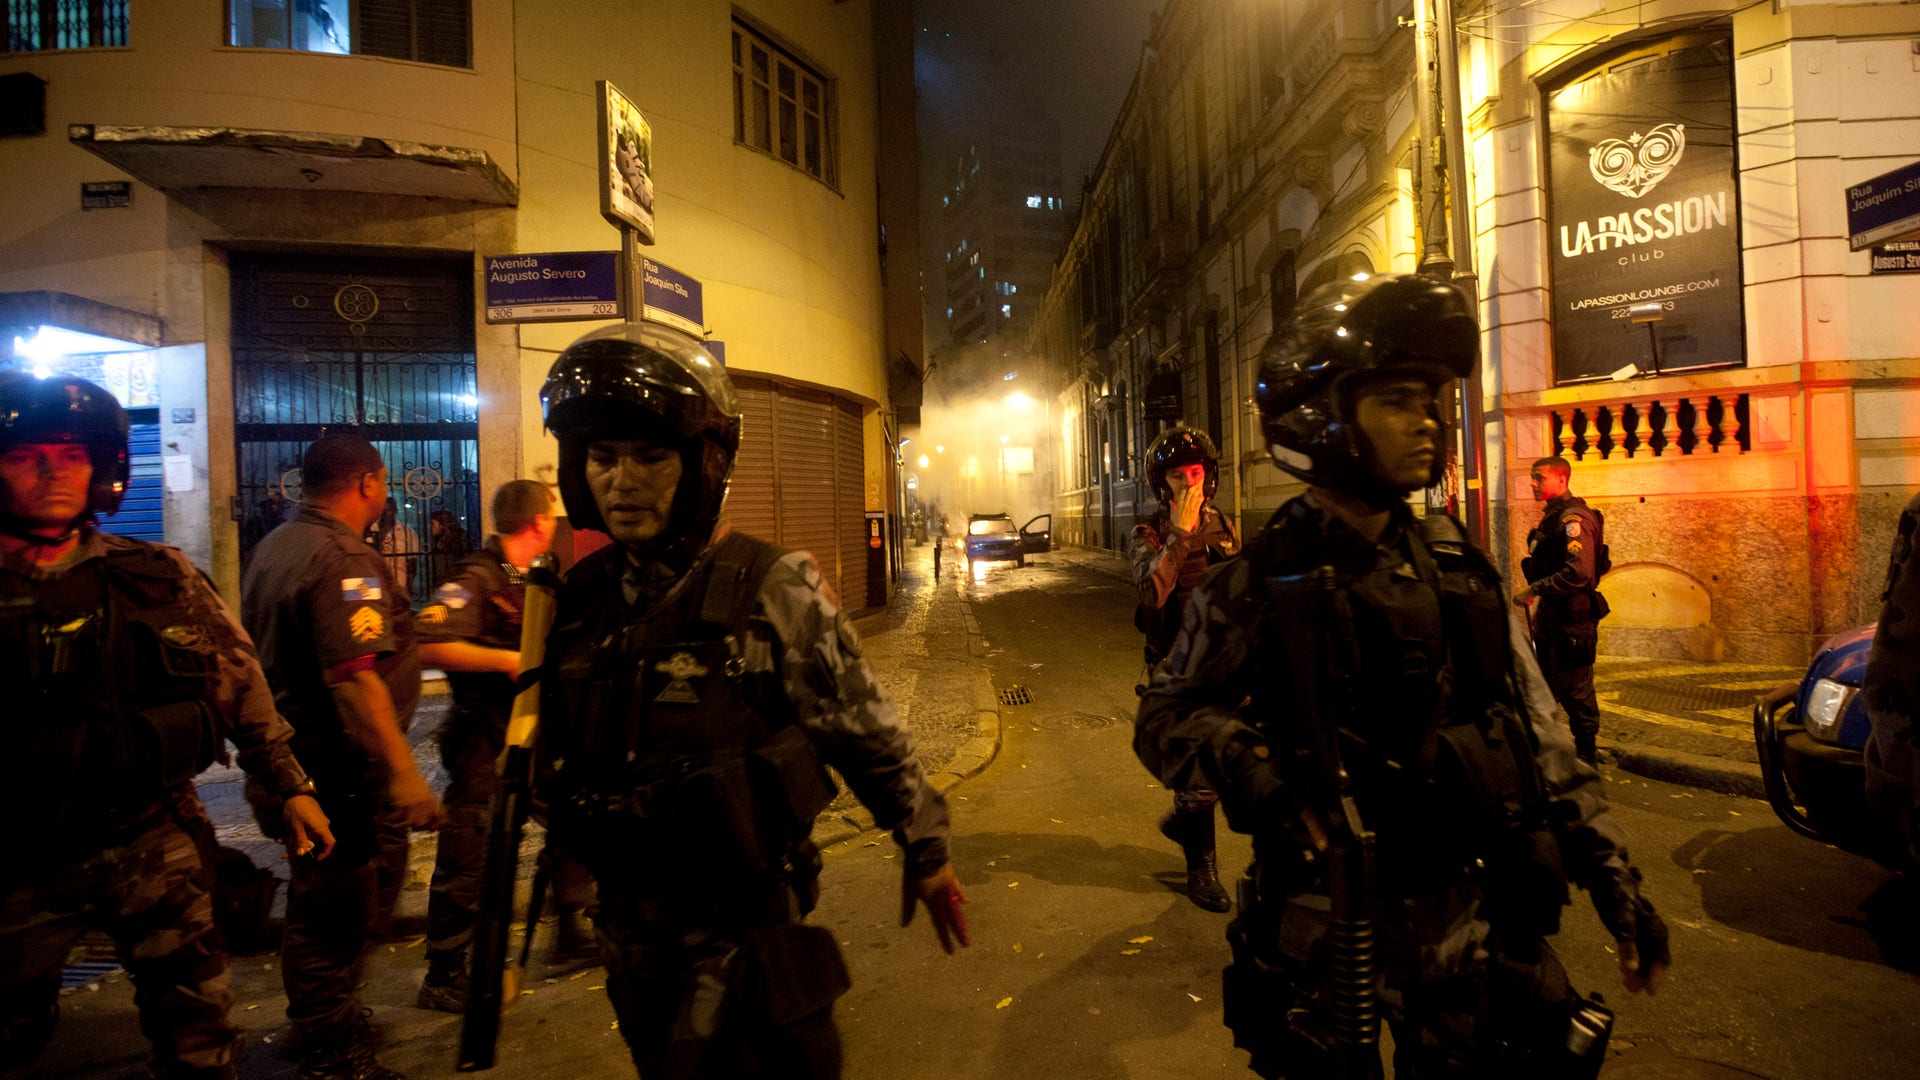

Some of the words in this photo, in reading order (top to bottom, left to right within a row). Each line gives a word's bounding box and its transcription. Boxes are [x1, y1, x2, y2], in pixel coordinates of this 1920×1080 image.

[1850, 184, 1873, 200] Rua
[1851, 189, 1902, 212] Joaquim
[1560, 221, 1594, 258] LA
[1598, 191, 1727, 251] PASSION
[1854, 234, 1867, 247] 10
[490, 256, 538, 271] Avenida
[1618, 249, 1665, 266] club
[1873, 255, 1906, 269] AUGUSTO
[643, 258, 659, 274] Rua
[490, 269, 540, 284] Augusto
[542, 268, 586, 280] Severo
[643, 272, 675, 292] Joaquim
[1570, 278, 1720, 310] LAPASSIONLOUNGE.COM
[493, 308, 513, 319] 306
[592, 304, 613, 314] 202
